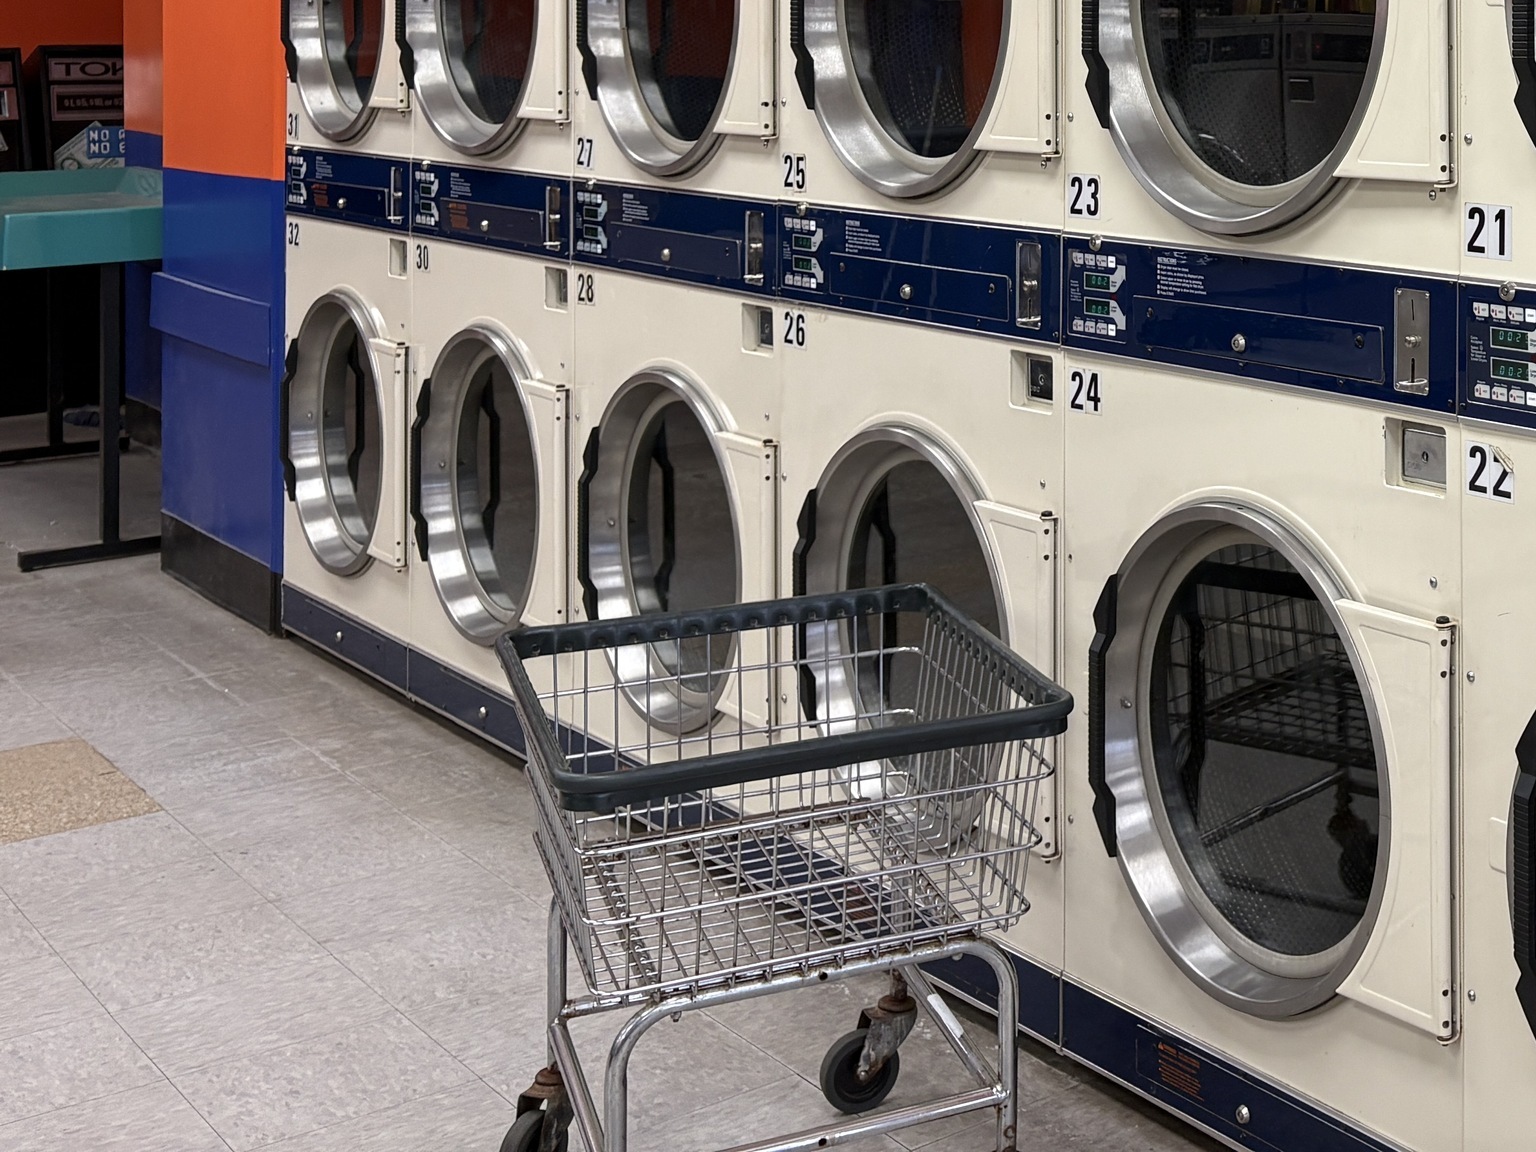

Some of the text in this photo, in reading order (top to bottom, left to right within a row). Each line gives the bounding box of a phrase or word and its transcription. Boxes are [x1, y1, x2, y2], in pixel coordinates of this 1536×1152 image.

[89, 129, 110, 141] NO
[288, 114, 299, 137] 31
[90, 142, 110, 154] NO
[577, 138, 593, 167] 27
[784, 155, 805, 189] 25
[1070, 176, 1099, 216] 23
[288, 223, 299, 246] 32
[1467, 207, 1506, 256] 21
[416, 245, 429, 270] 30
[578, 274, 594, 302] 28
[784, 311, 805, 347] 26
[1070, 371, 1100, 412] 24
[1469, 445, 1512, 499] 22
